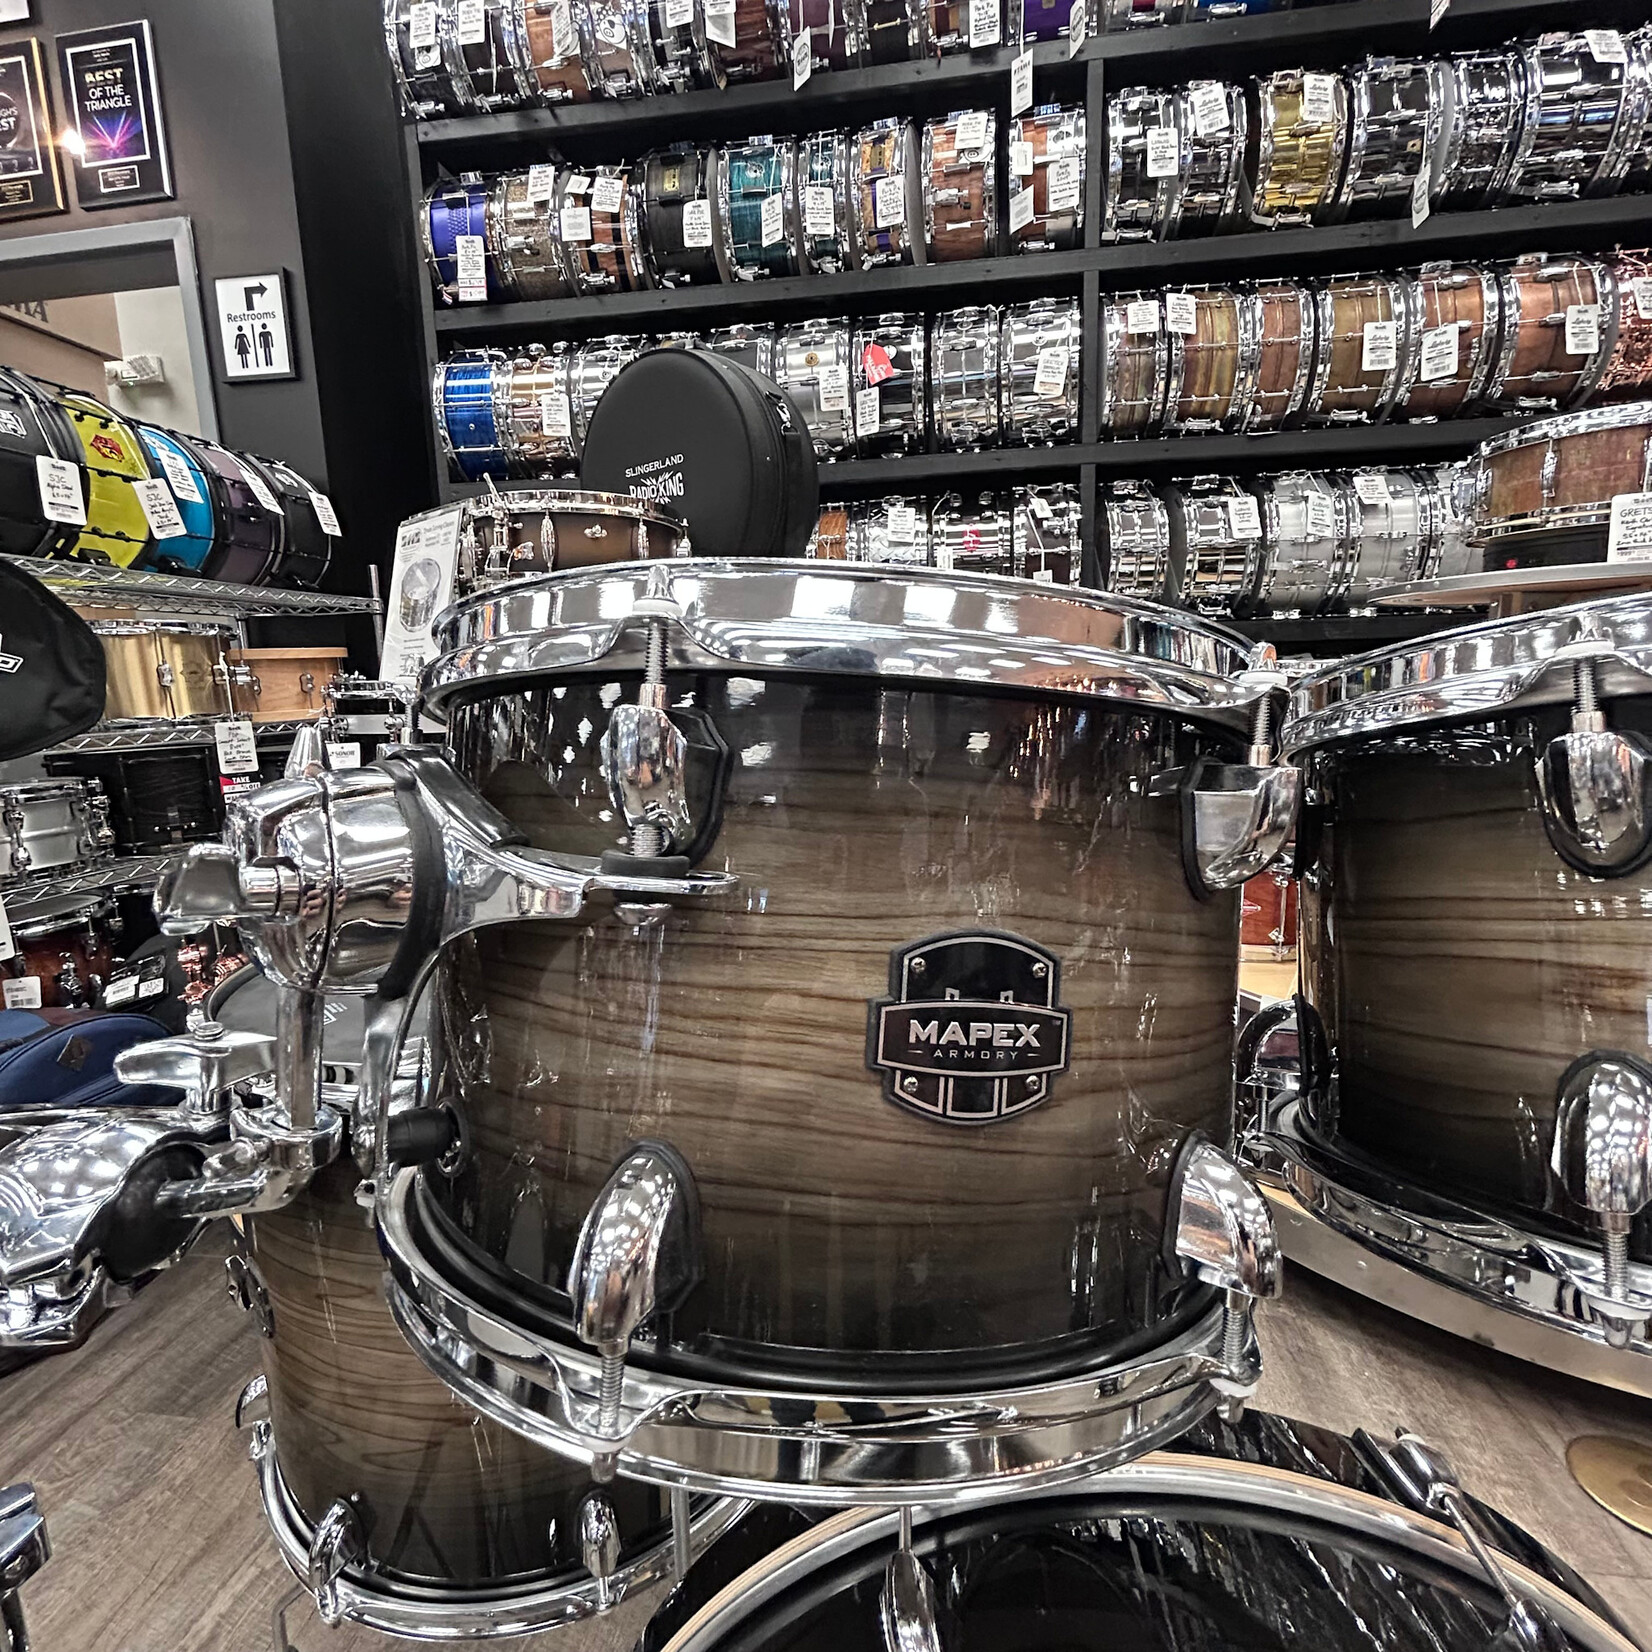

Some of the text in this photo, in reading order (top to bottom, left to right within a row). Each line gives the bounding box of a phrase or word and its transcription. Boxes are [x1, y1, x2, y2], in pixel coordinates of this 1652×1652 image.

[84, 67, 124, 83] BEST
[88, 84, 125, 100] OF THE
[84, 95, 132, 112] TRIANGLE
[226, 310, 276, 323] Restrooms
[625, 454, 684, 478] SLINGERLAND
[659, 472, 684, 497] KING
[232, 776, 251, 784] TAKE
[908, 1019, 1042, 1048] MAPEX
[932, 1049, 1020, 1061] ARMORY
